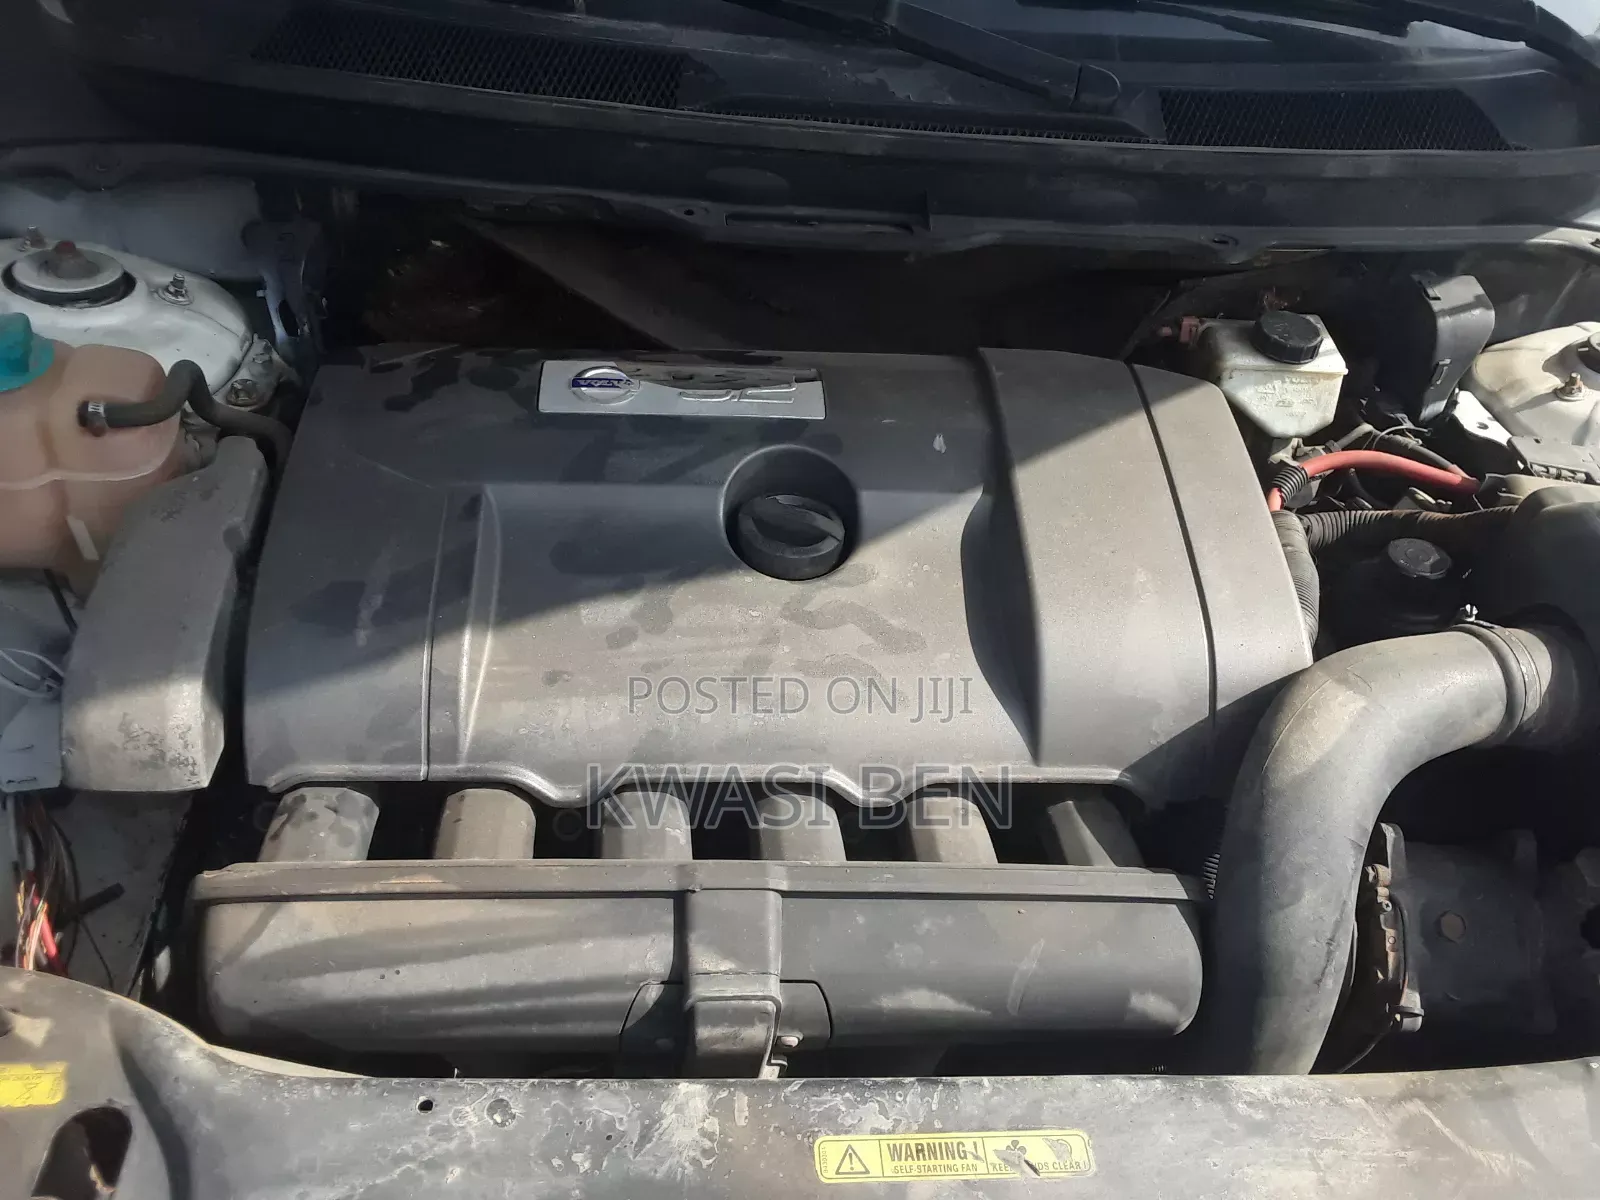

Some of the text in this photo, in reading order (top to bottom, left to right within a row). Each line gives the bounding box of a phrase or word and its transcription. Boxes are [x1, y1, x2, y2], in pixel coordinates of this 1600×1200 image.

[886, 1141, 968, 1162] WARNING
[893, 1163, 978, 1174] SELF-STARTING FAN
